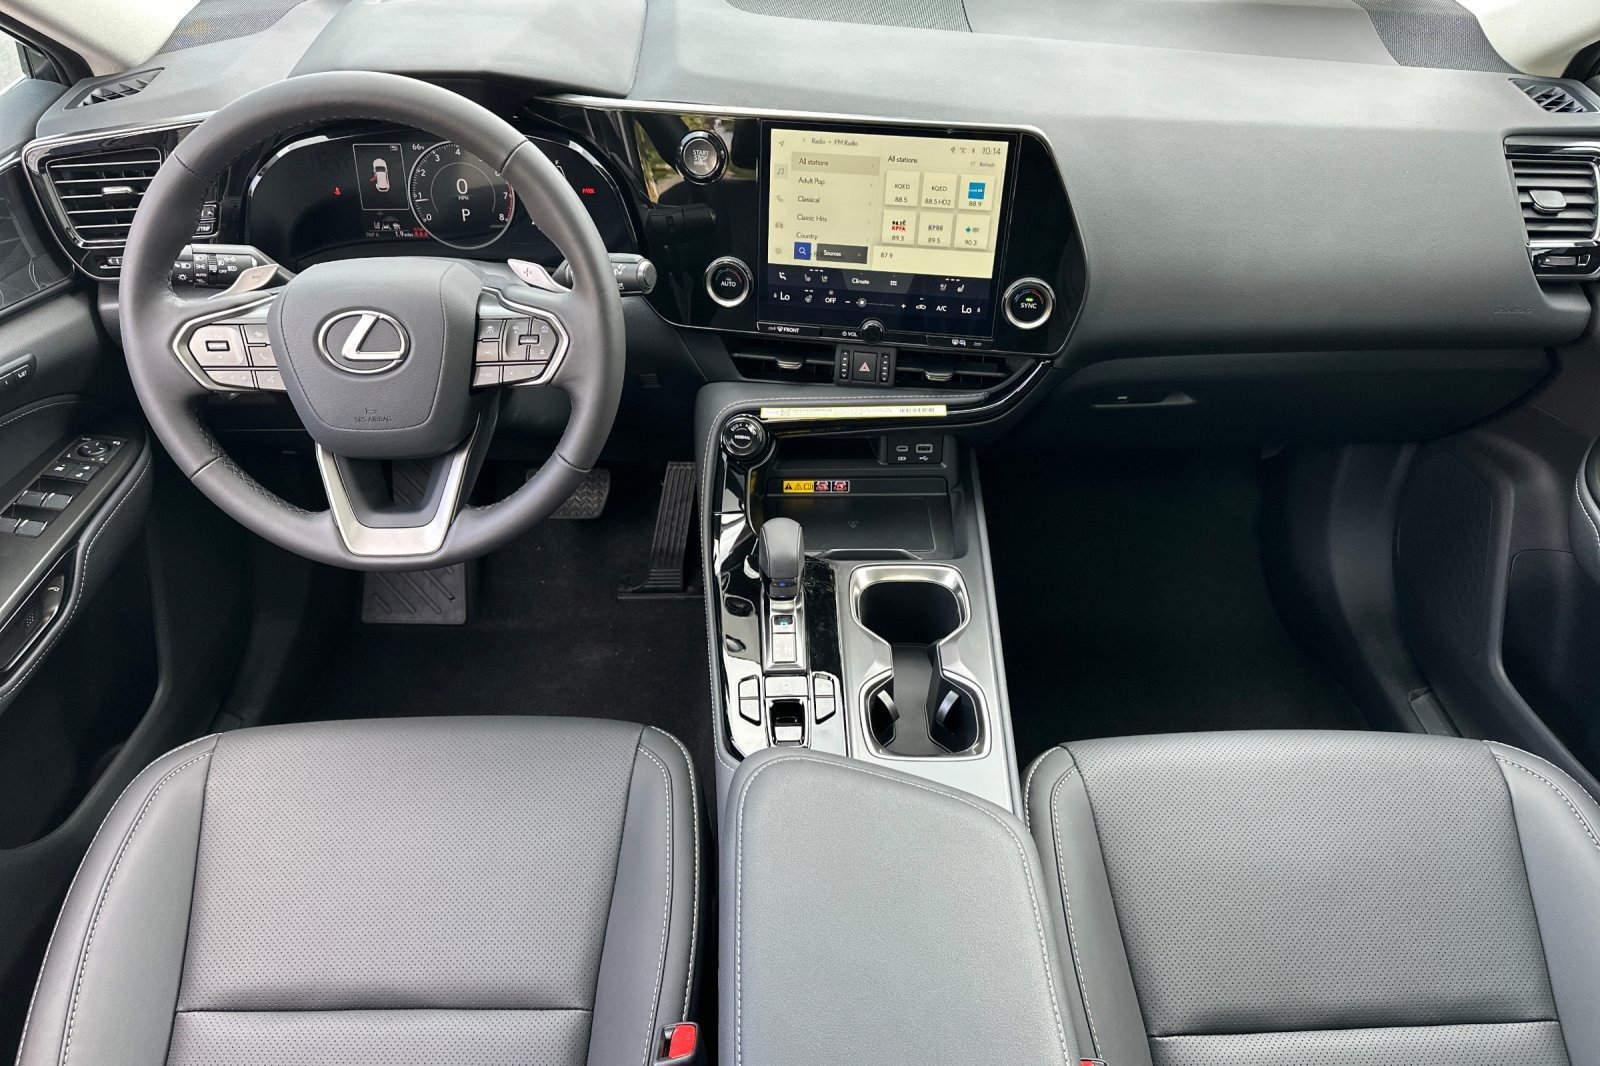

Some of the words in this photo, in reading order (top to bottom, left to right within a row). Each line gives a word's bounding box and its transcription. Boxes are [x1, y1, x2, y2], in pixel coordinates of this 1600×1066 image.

[811, 137, 826, 145] Radio
[834, 138, 843, 146] FM
[455, 147, 461, 156] 4
[982, 147, 1001, 155] 10:14
[435, 154, 440, 162] 3
[807, 158, 829, 166] stations
[896, 156, 918, 164] stations
[420, 169, 426, 177] 2
[814, 177, 825, 186] Pop
[456, 178, 468, 195] 0
[797, 195, 821, 203] Classical
[426, 213, 432, 221] 0
[462, 208, 471, 221] P
[499, 213, 505, 221] 8
[796, 213, 815, 222] Classic
[816, 214, 827, 222] Hits
[796, 231, 818, 240] Country
[823, 249, 842, 257] Sources
[720, 280, 737, 288] AUTO
[851, 277, 870, 285] Climate
[780, 291, 791, 301] Lo
[961, 304, 972, 314] Lo
[783, 326, 800, 334] FRONT
